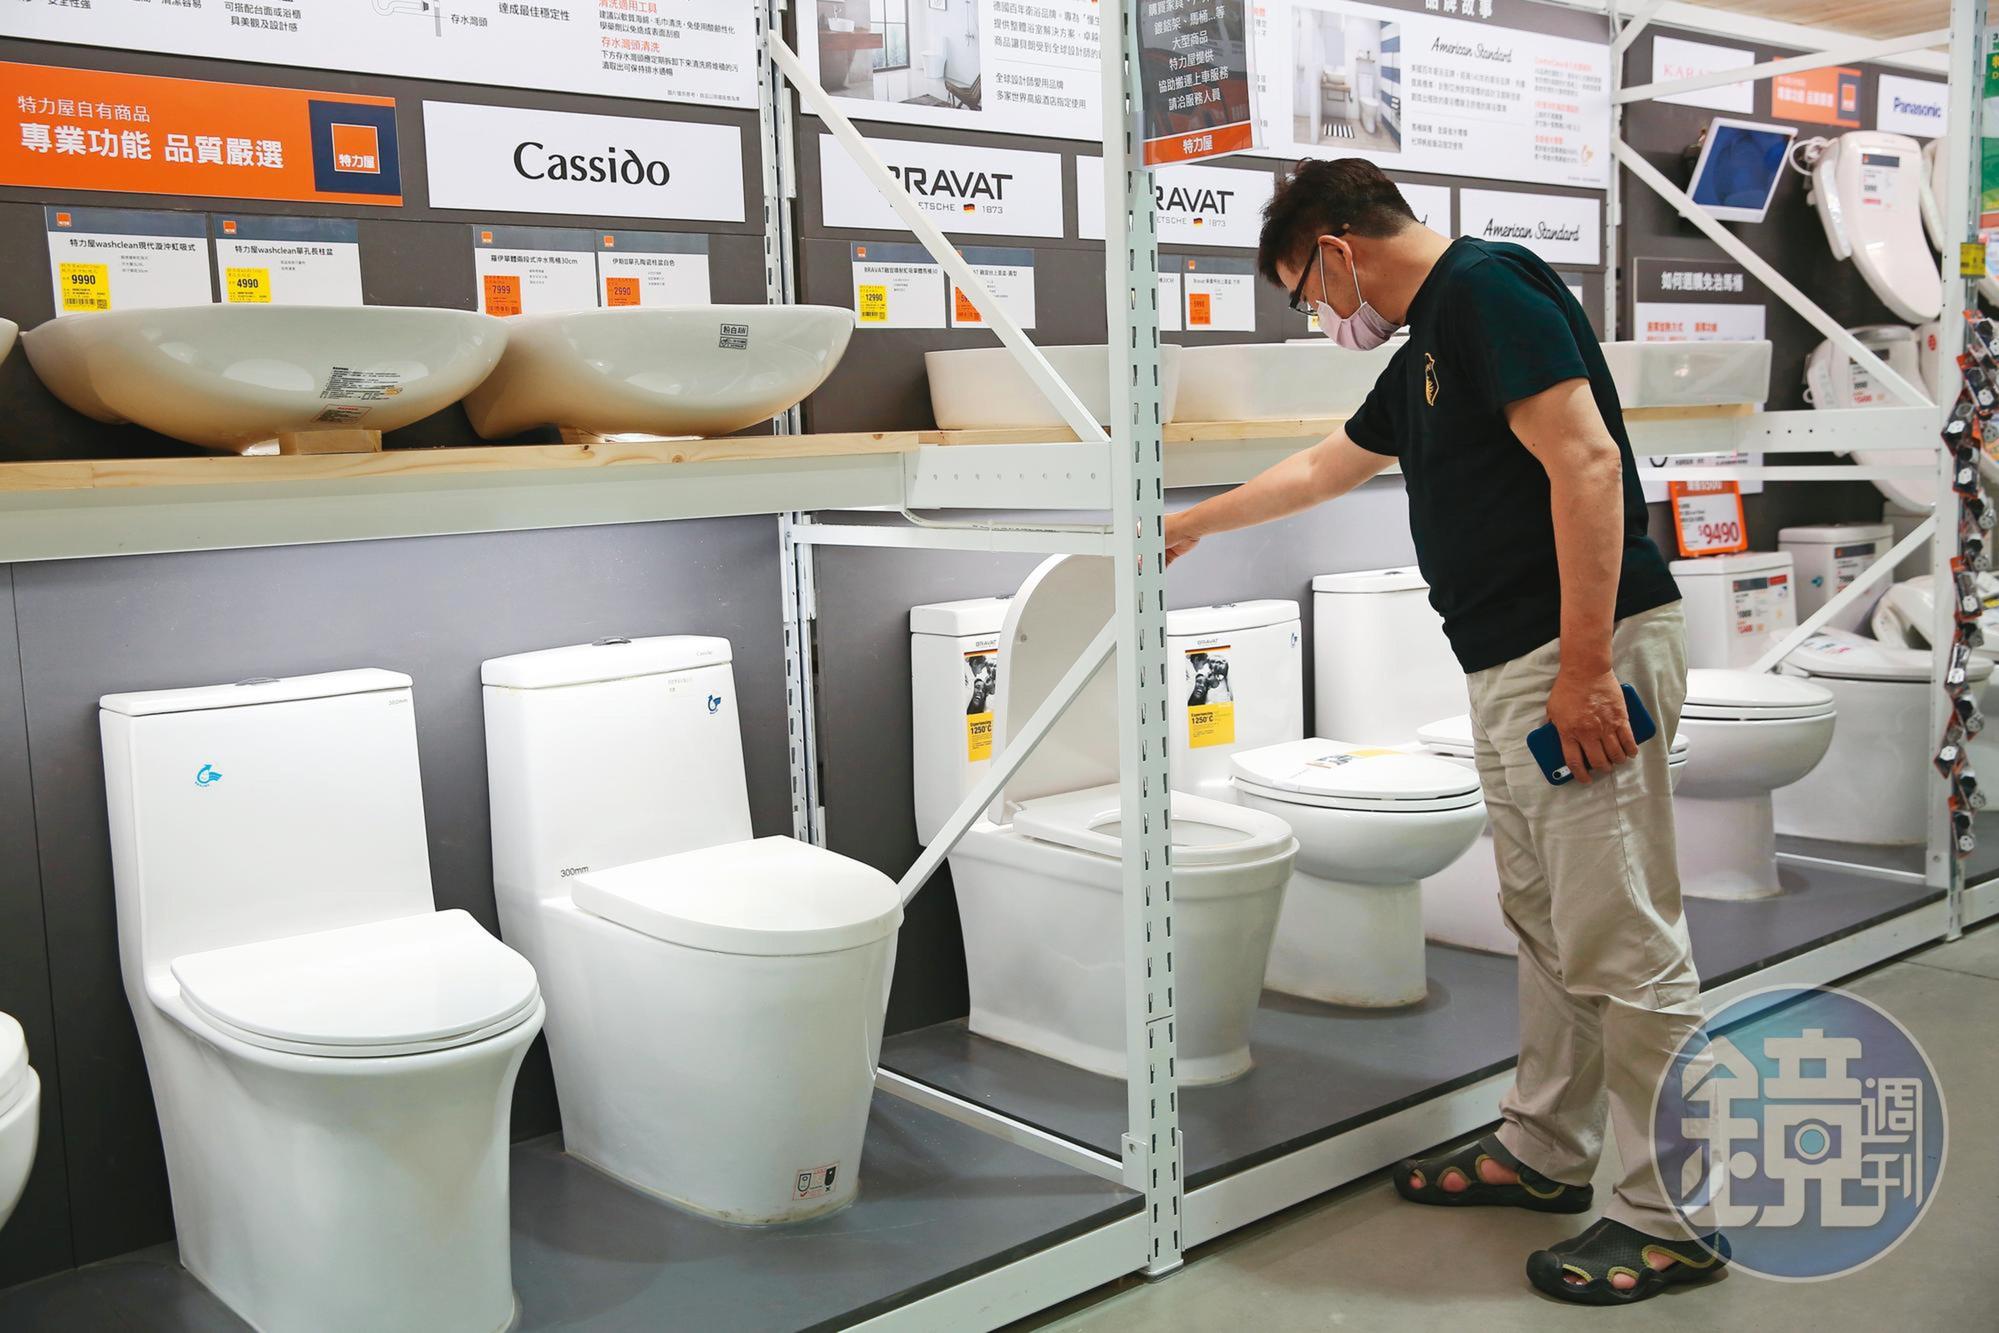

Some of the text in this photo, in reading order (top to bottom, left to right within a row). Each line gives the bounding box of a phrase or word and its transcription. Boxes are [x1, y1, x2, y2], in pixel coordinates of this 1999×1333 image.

[224, 1, 302, 20] 可搭配台面或浴櫃
[499, 2, 570, 21] 達成最佳穩定性
[230, 16, 298, 32] 具美觀及設計感
[1172, 30, 1209, 50] 大型商品
[1169, 49, 1214, 71] 特力屋提供
[1158, 66, 1229, 93] 協助搬運上車服務
[1168, 88, 1221, 111] 請洽服務人員
[1893, 97, 1941, 119] Panasonic
[17, 96, 151, 123] 特力屋自有商品
[20, 122, 284, 169] 專業功能 品質嚴選
[1182, 135, 1213, 154] 特力屋
[338, 153, 375, 169] 特力屋
[513, 141, 670, 186] Cassido
[917, 202, 1003, 214] ETSCHE 1873
[1155, 186, 1234, 214] RAVAT
[1208, 218, 1226, 227] 1873
[1483, 218, 1580, 241] American Standard
[72, 274, 96, 285] 9990
[237, 278, 259, 288] 4990
[492, 285, 511, 294] 7999
[614, 287, 631, 296] 2990
[560, 866, 589, 877] 300mm
